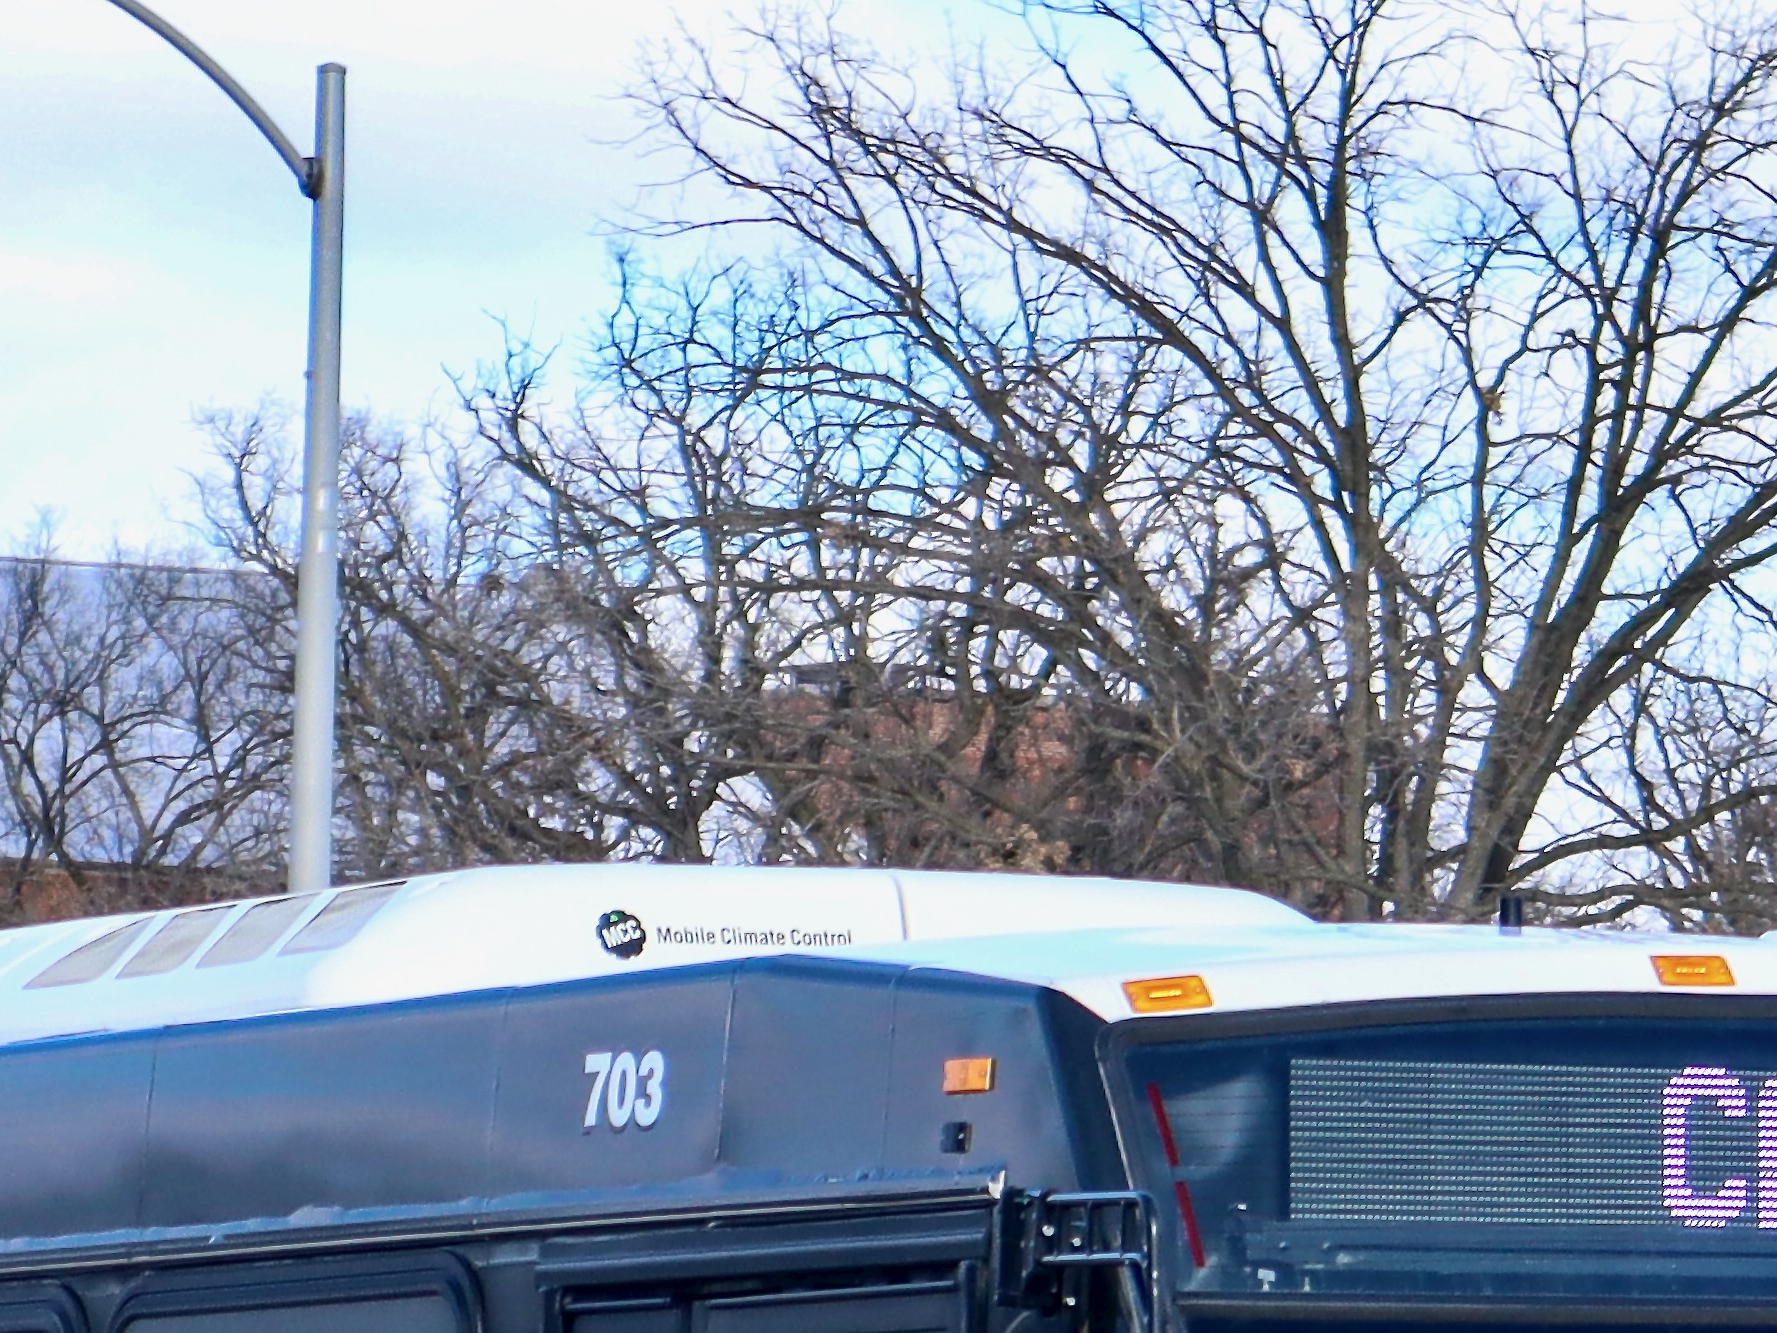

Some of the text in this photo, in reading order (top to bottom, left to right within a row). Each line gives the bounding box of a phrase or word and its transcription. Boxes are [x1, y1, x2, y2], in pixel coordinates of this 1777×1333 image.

[656, 926, 852, 947] Mobile Climate Control
[583, 1050, 663, 1129] 703
